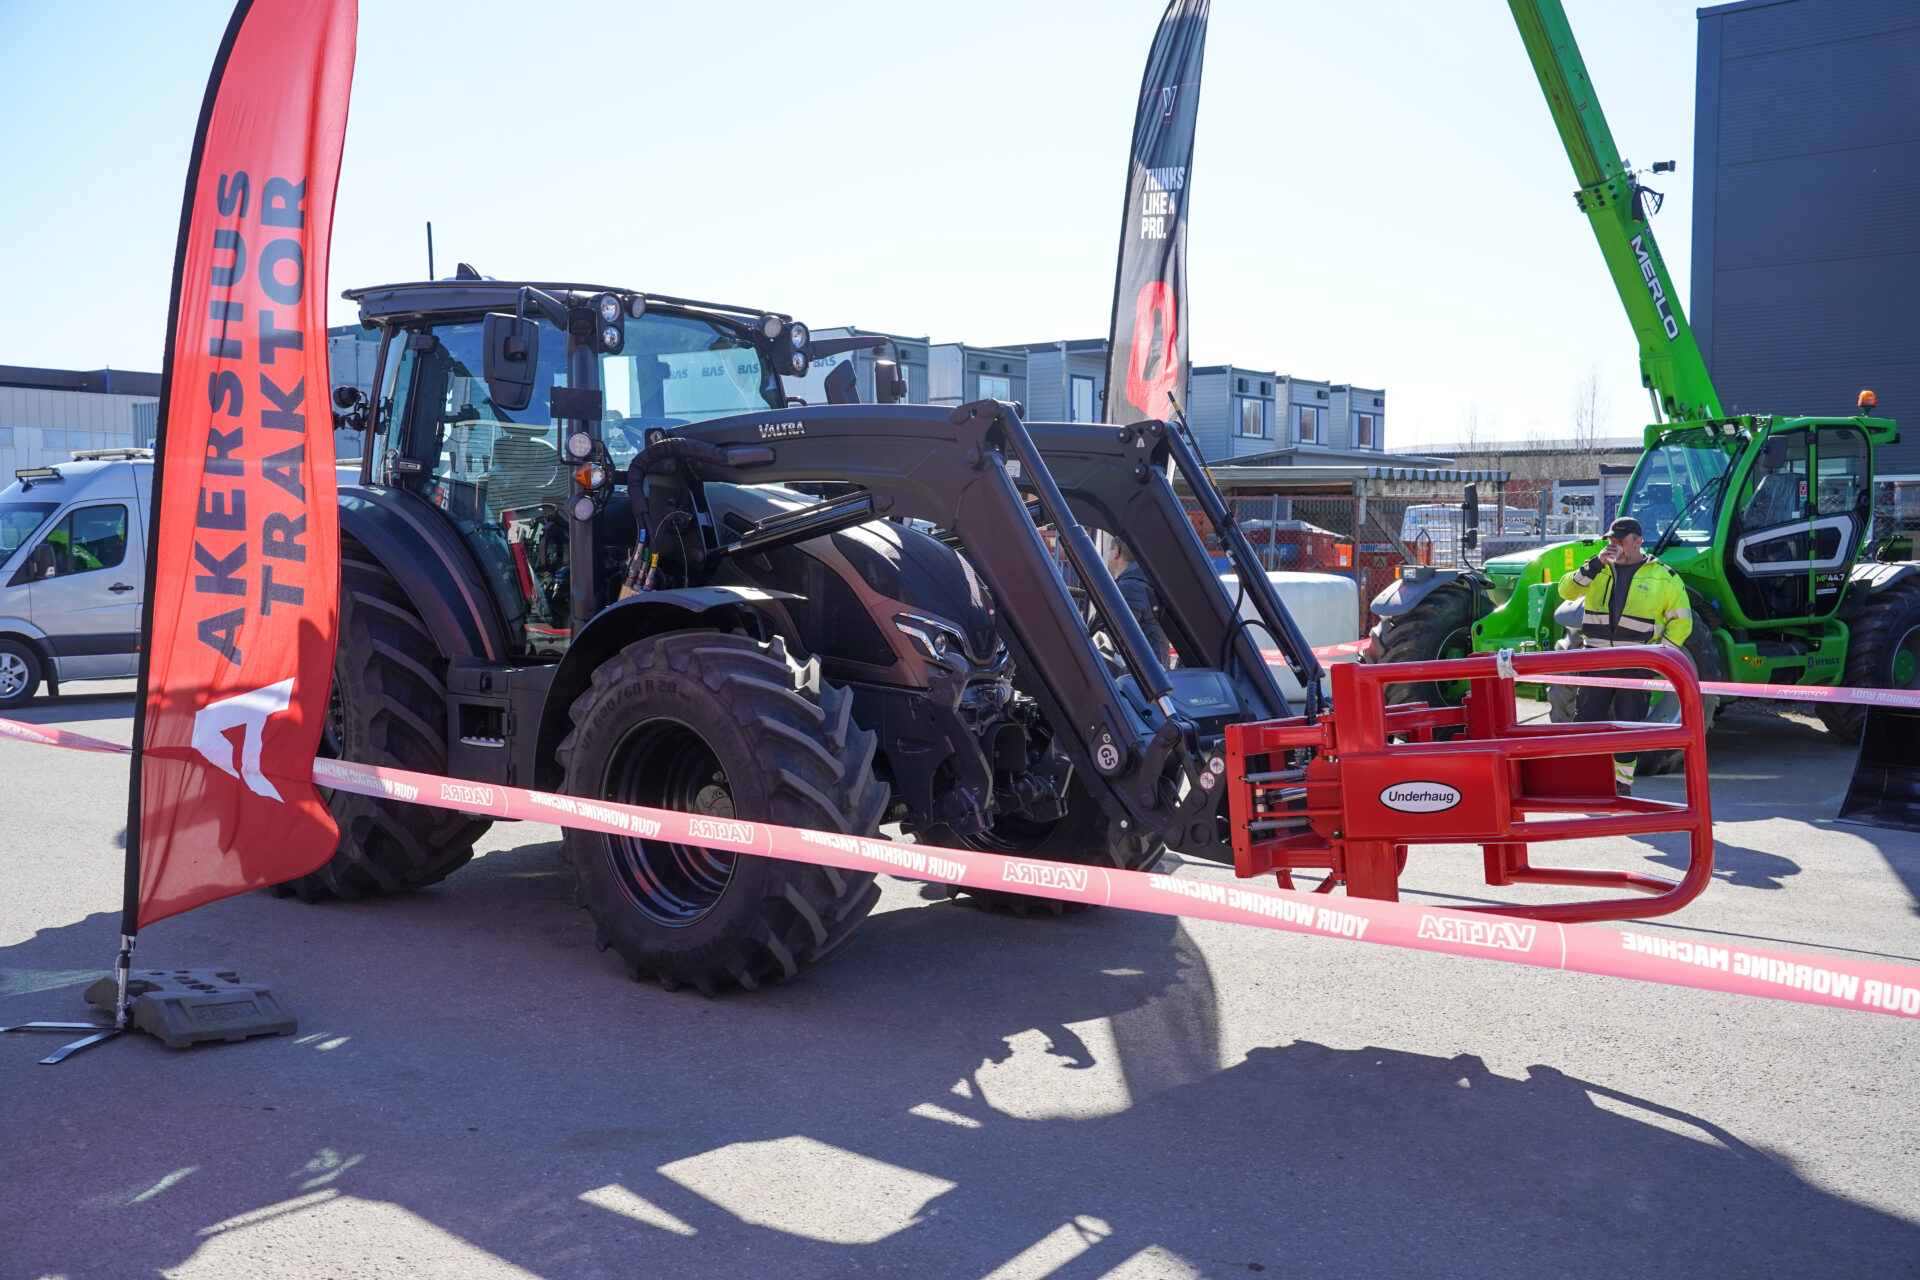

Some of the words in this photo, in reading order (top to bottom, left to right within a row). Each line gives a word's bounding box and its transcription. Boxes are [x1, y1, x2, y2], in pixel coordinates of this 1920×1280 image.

[1145, 166, 1185, 191] THINKS
[1142, 192, 1167, 215] LIKE
[1168, 192, 1175, 214] A
[1141, 216, 1167, 239] PRO.
[1630, 233, 1680, 341] MERLO
[702, 366, 725, 378] BAS
[738, 363, 760, 375] BAS
[813, 355, 837, 368] BAS
[258, 175, 307, 617] TRAKTOR
[194, 170, 250, 667] AKERSHUS
[758, 421, 806, 439] VALTRA
[1815, 656, 1840, 666] HYMAX
[1100, 747, 1117, 767] G5
[1388, 791, 1454, 803] Underhaug
